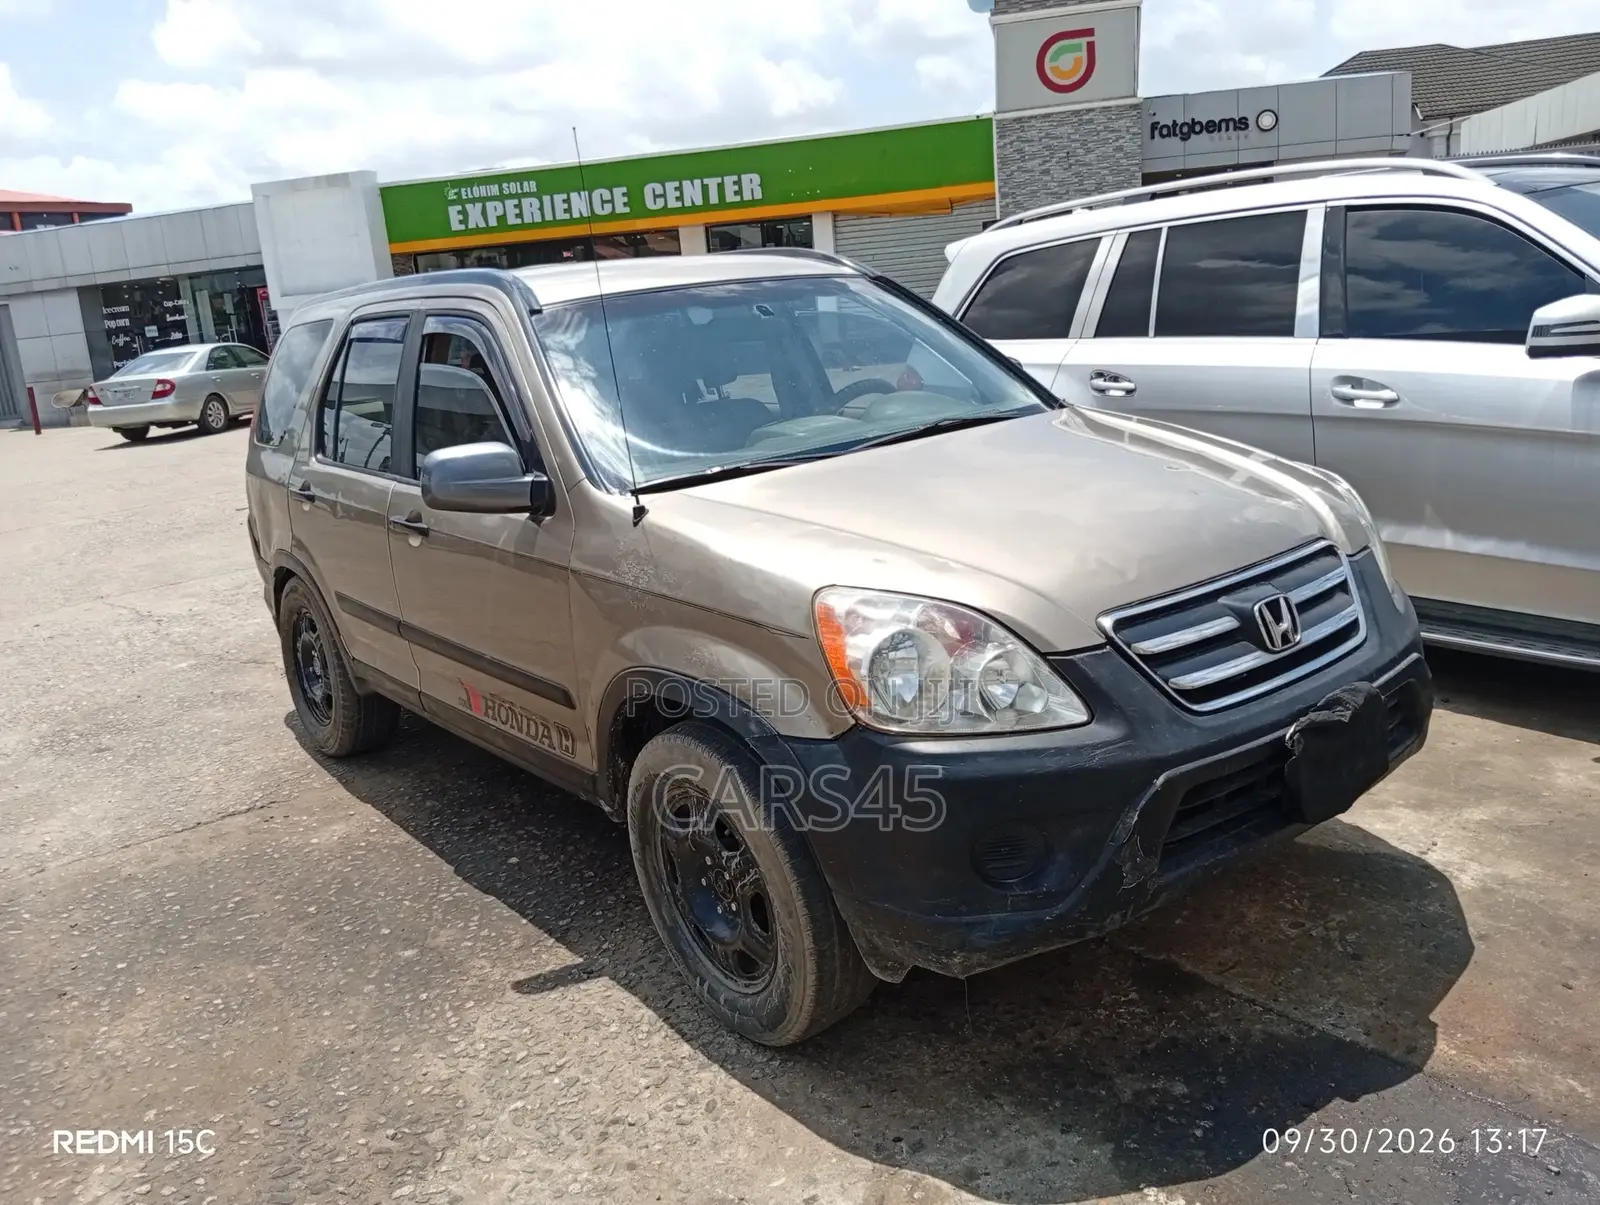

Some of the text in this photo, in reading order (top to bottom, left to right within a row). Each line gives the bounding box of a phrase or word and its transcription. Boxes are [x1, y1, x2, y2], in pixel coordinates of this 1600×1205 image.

[1150, 116, 1250, 142] fatgbems
[501, 180, 537, 195] SOLAR
[448, 173, 763, 231] EXPERIENCE CENTER
[111, 333, 131, 347] Coffee
[484, 697, 556, 750] HONDA
